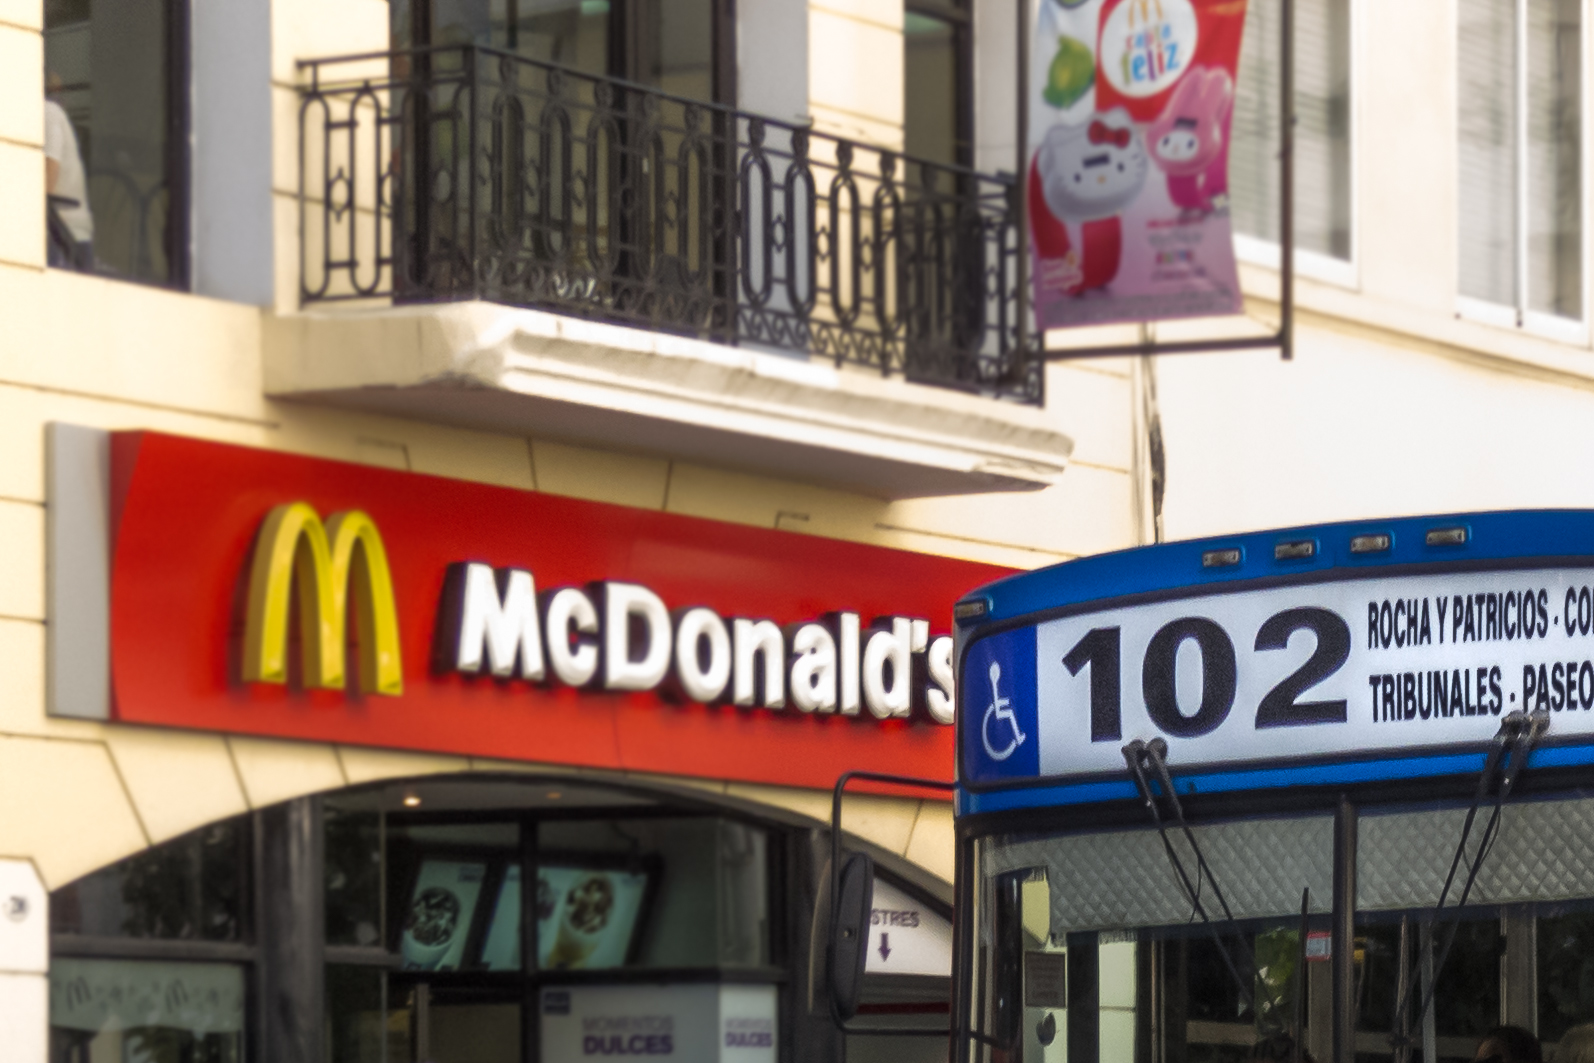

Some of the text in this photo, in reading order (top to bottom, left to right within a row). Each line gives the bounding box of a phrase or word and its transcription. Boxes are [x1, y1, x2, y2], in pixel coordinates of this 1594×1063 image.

[456, 561, 955, 725] McDonald's
[1367, 595, 1430, 651] ROCHA
[1429, 596, 1449, 644] Y
[1451, 588, 1551, 642] PATRICIOS
[1061, 605, 1353, 743] 102
[1367, 664, 1505, 724] TRIBUNALES
[582, 1034, 674, 1056] DULCES
